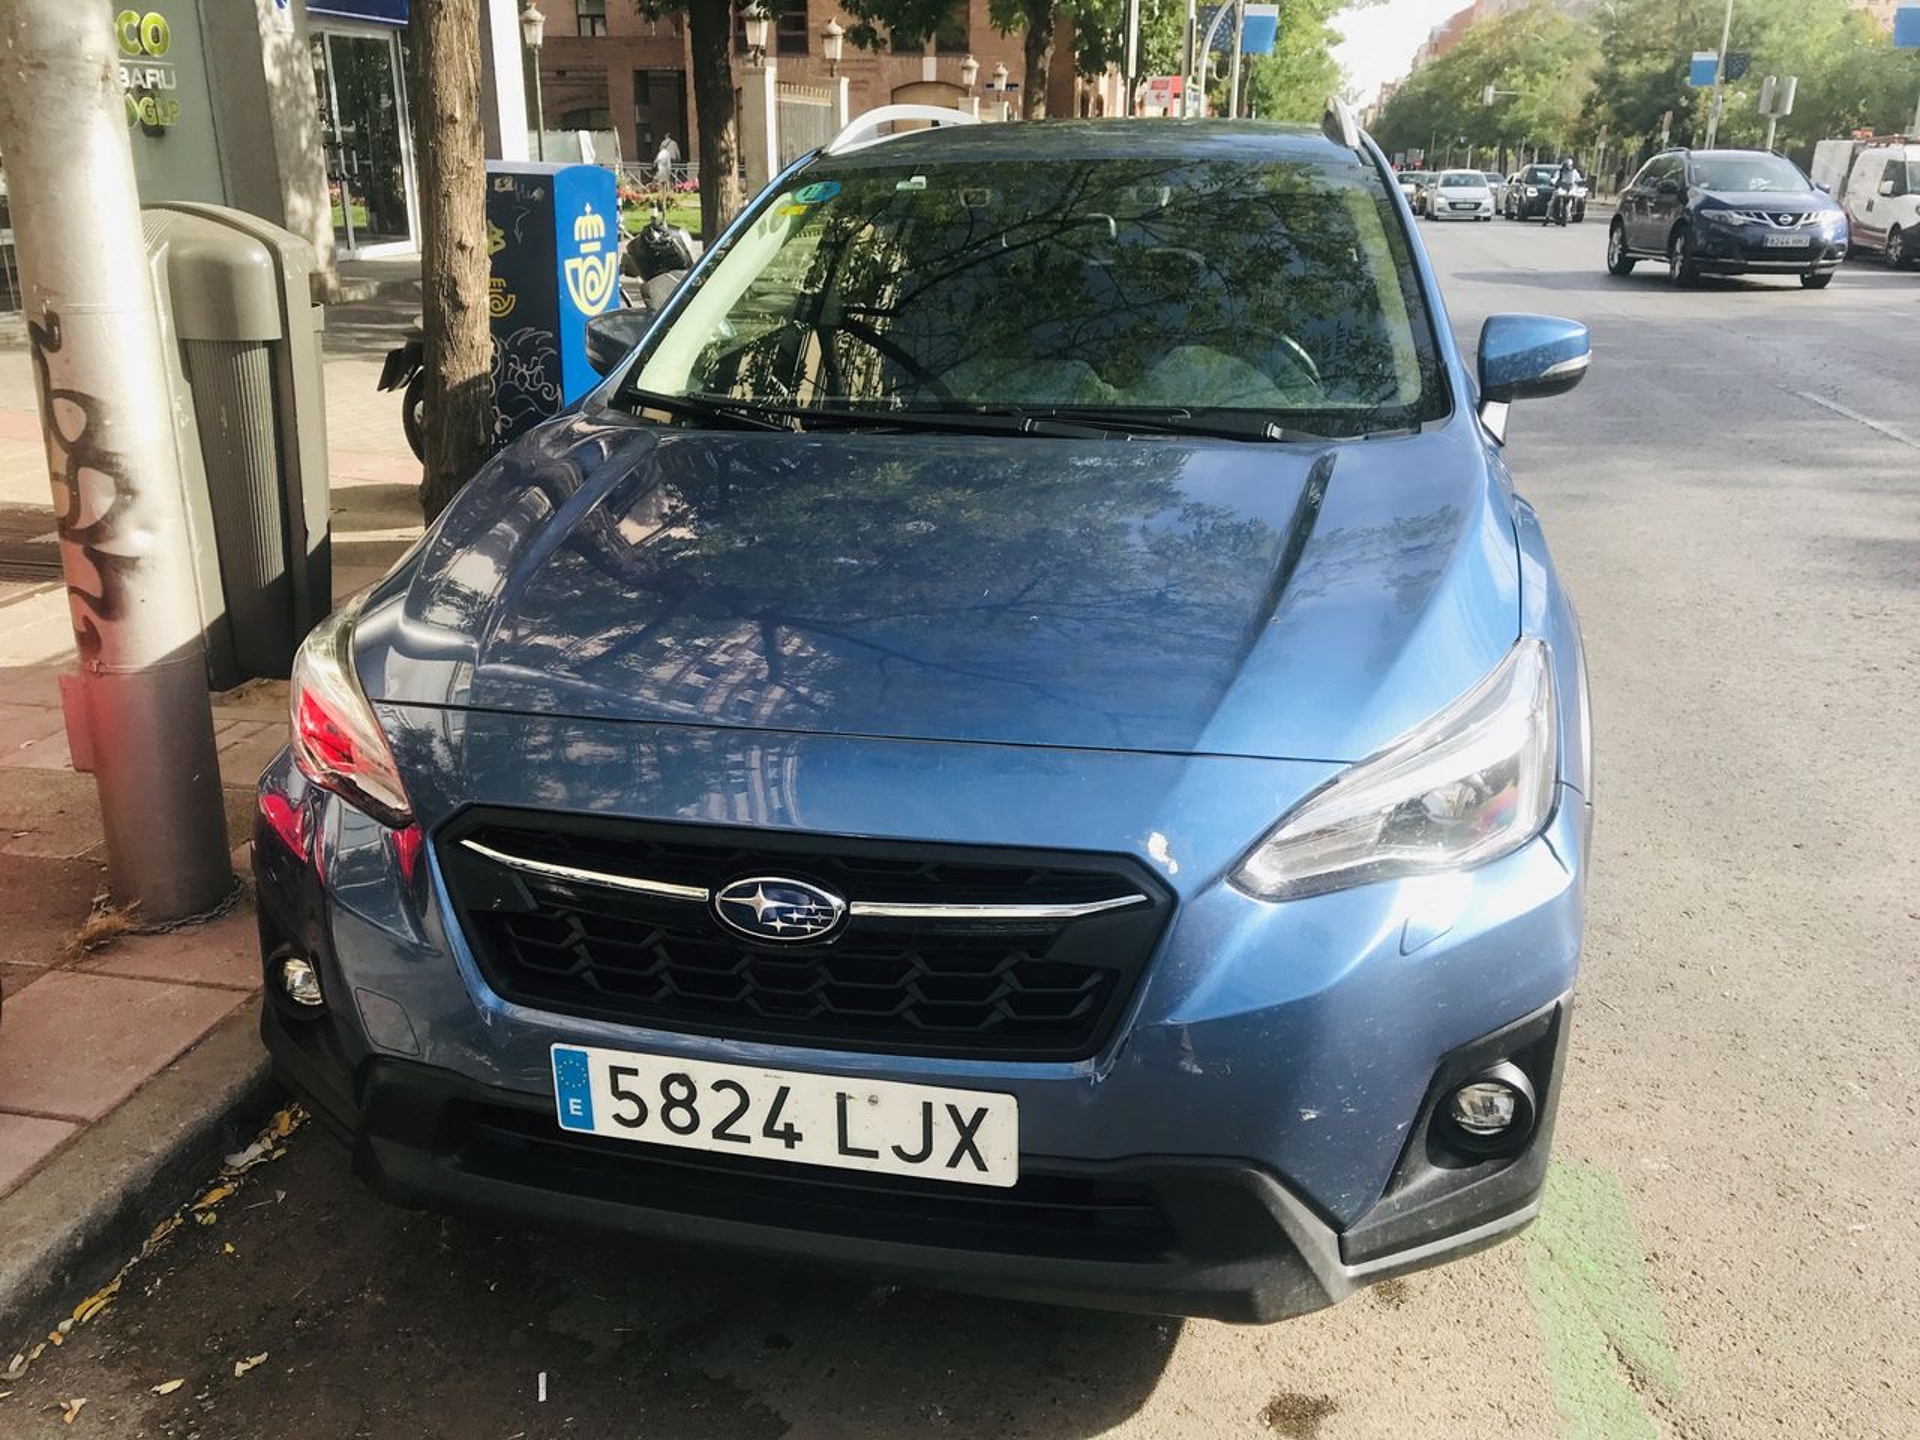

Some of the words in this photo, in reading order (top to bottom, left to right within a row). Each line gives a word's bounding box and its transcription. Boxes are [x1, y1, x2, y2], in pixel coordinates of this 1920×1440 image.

[115, 10, 170, 57] CO
[119, 66, 177, 90] BARU
[569, 1098, 583, 1117] E
[608, 1064, 803, 1150] 5824
[835, 1091, 990, 1173] LJX
